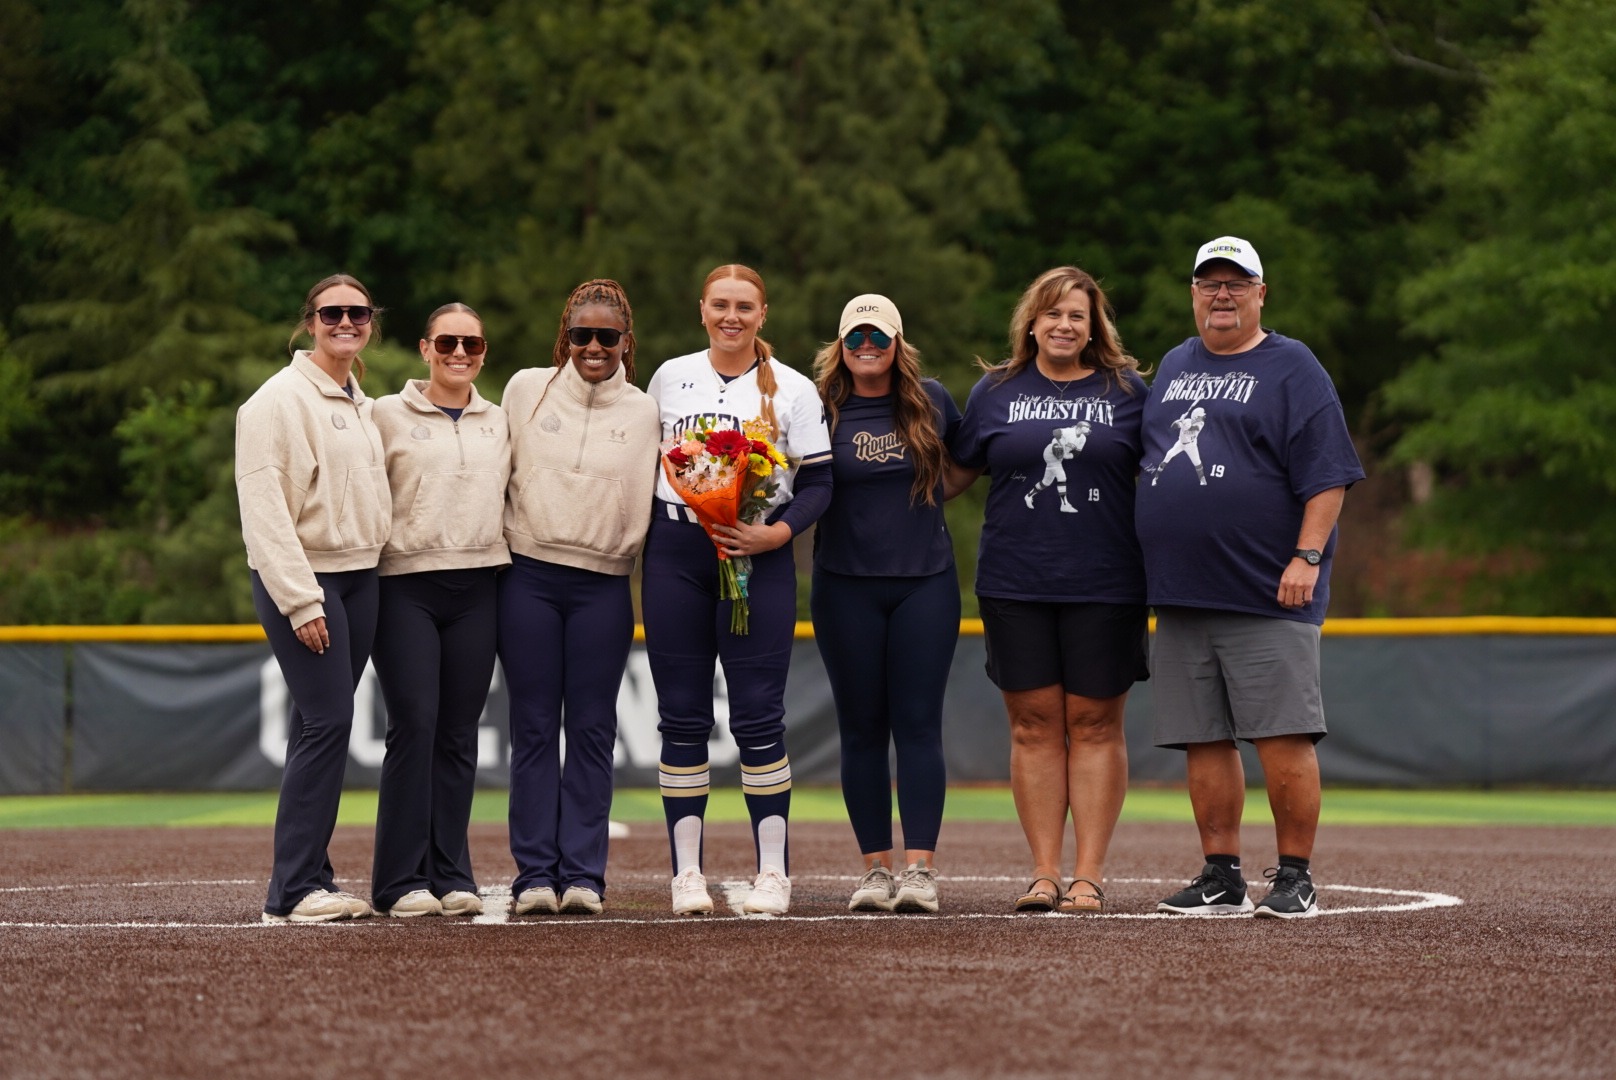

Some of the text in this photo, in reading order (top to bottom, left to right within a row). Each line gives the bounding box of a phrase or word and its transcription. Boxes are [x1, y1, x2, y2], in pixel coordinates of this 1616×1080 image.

[1207, 245, 1242, 254] QUEENS
[856, 305, 879, 313] QUC
[1161, 379, 1259, 404] BIGGEST FAN
[1007, 401, 1116, 427] BIGGEST FAN
[1210, 464, 1225, 478] 19
[1088, 488, 1100, 501] 19
